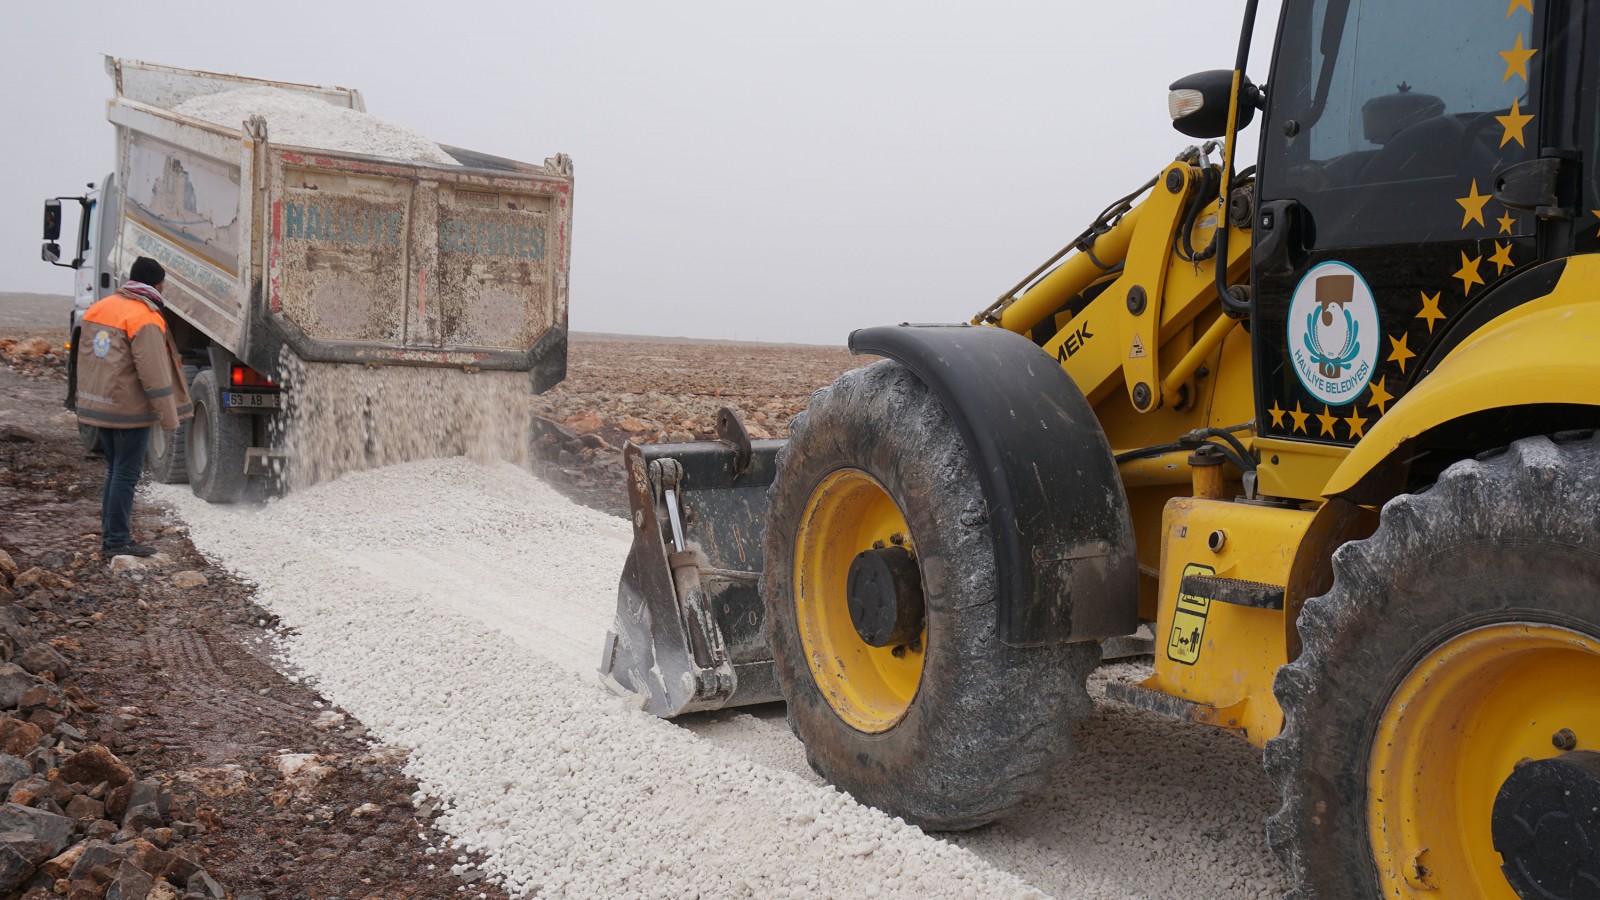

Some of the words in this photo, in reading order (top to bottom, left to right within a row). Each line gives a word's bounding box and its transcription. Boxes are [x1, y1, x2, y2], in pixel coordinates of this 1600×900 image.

[1294, 349, 1325, 391] HALİLİYE
[1325, 359, 1370, 394] BELEDİYESİ
[231, 394, 243, 405] 63
[250, 395, 262, 406] AB
